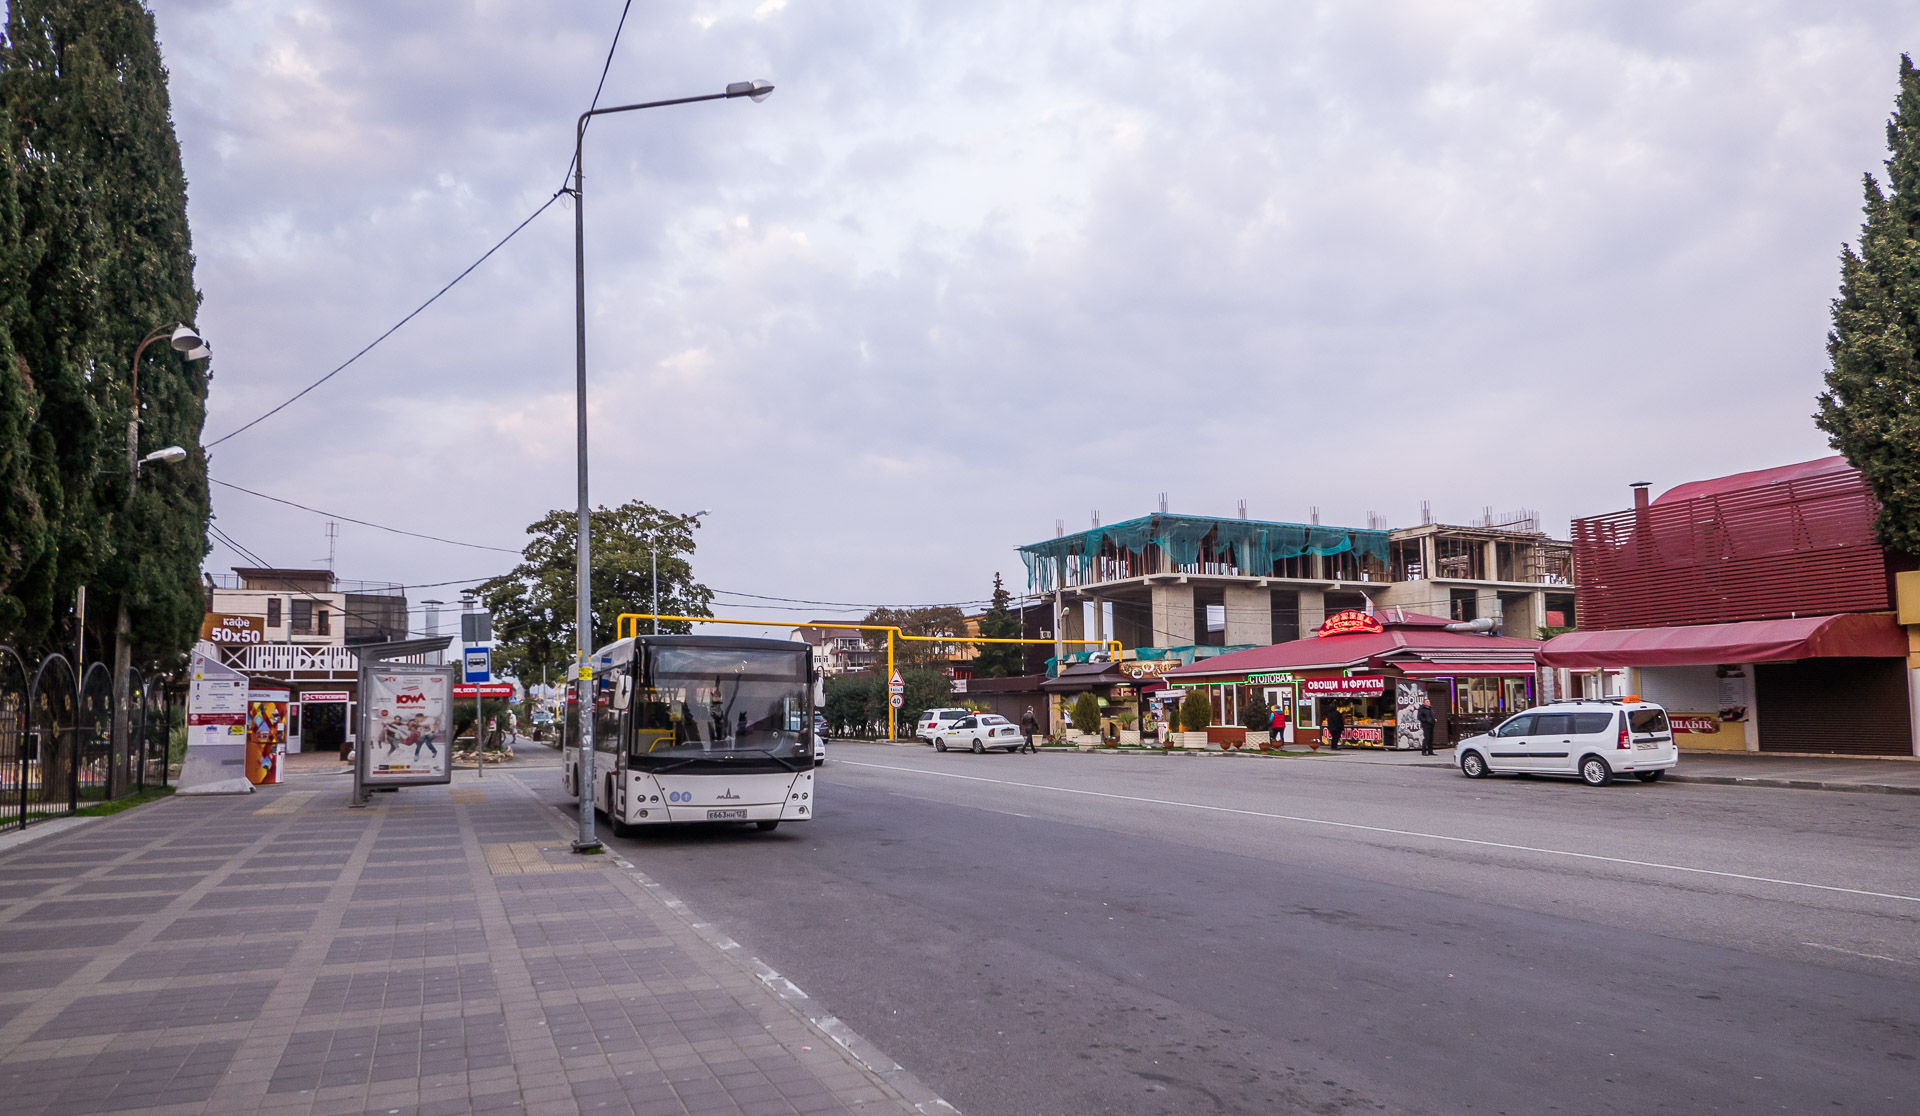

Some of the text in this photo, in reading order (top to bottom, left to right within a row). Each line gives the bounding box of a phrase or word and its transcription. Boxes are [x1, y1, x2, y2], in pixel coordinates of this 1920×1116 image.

[223, 616, 250, 629] кафе
[1249, 674, 1292, 684] СТОЛОВАЯ
[1307, 678, 1384, 691] ОВОЩИ И ФРУКТЫ
[1400, 722, 1421, 730] ФРУКТ
[1671, 720, 1713, 729] ШЛЫК
[1352, 728, 1382, 740] ФРУКТЫ
